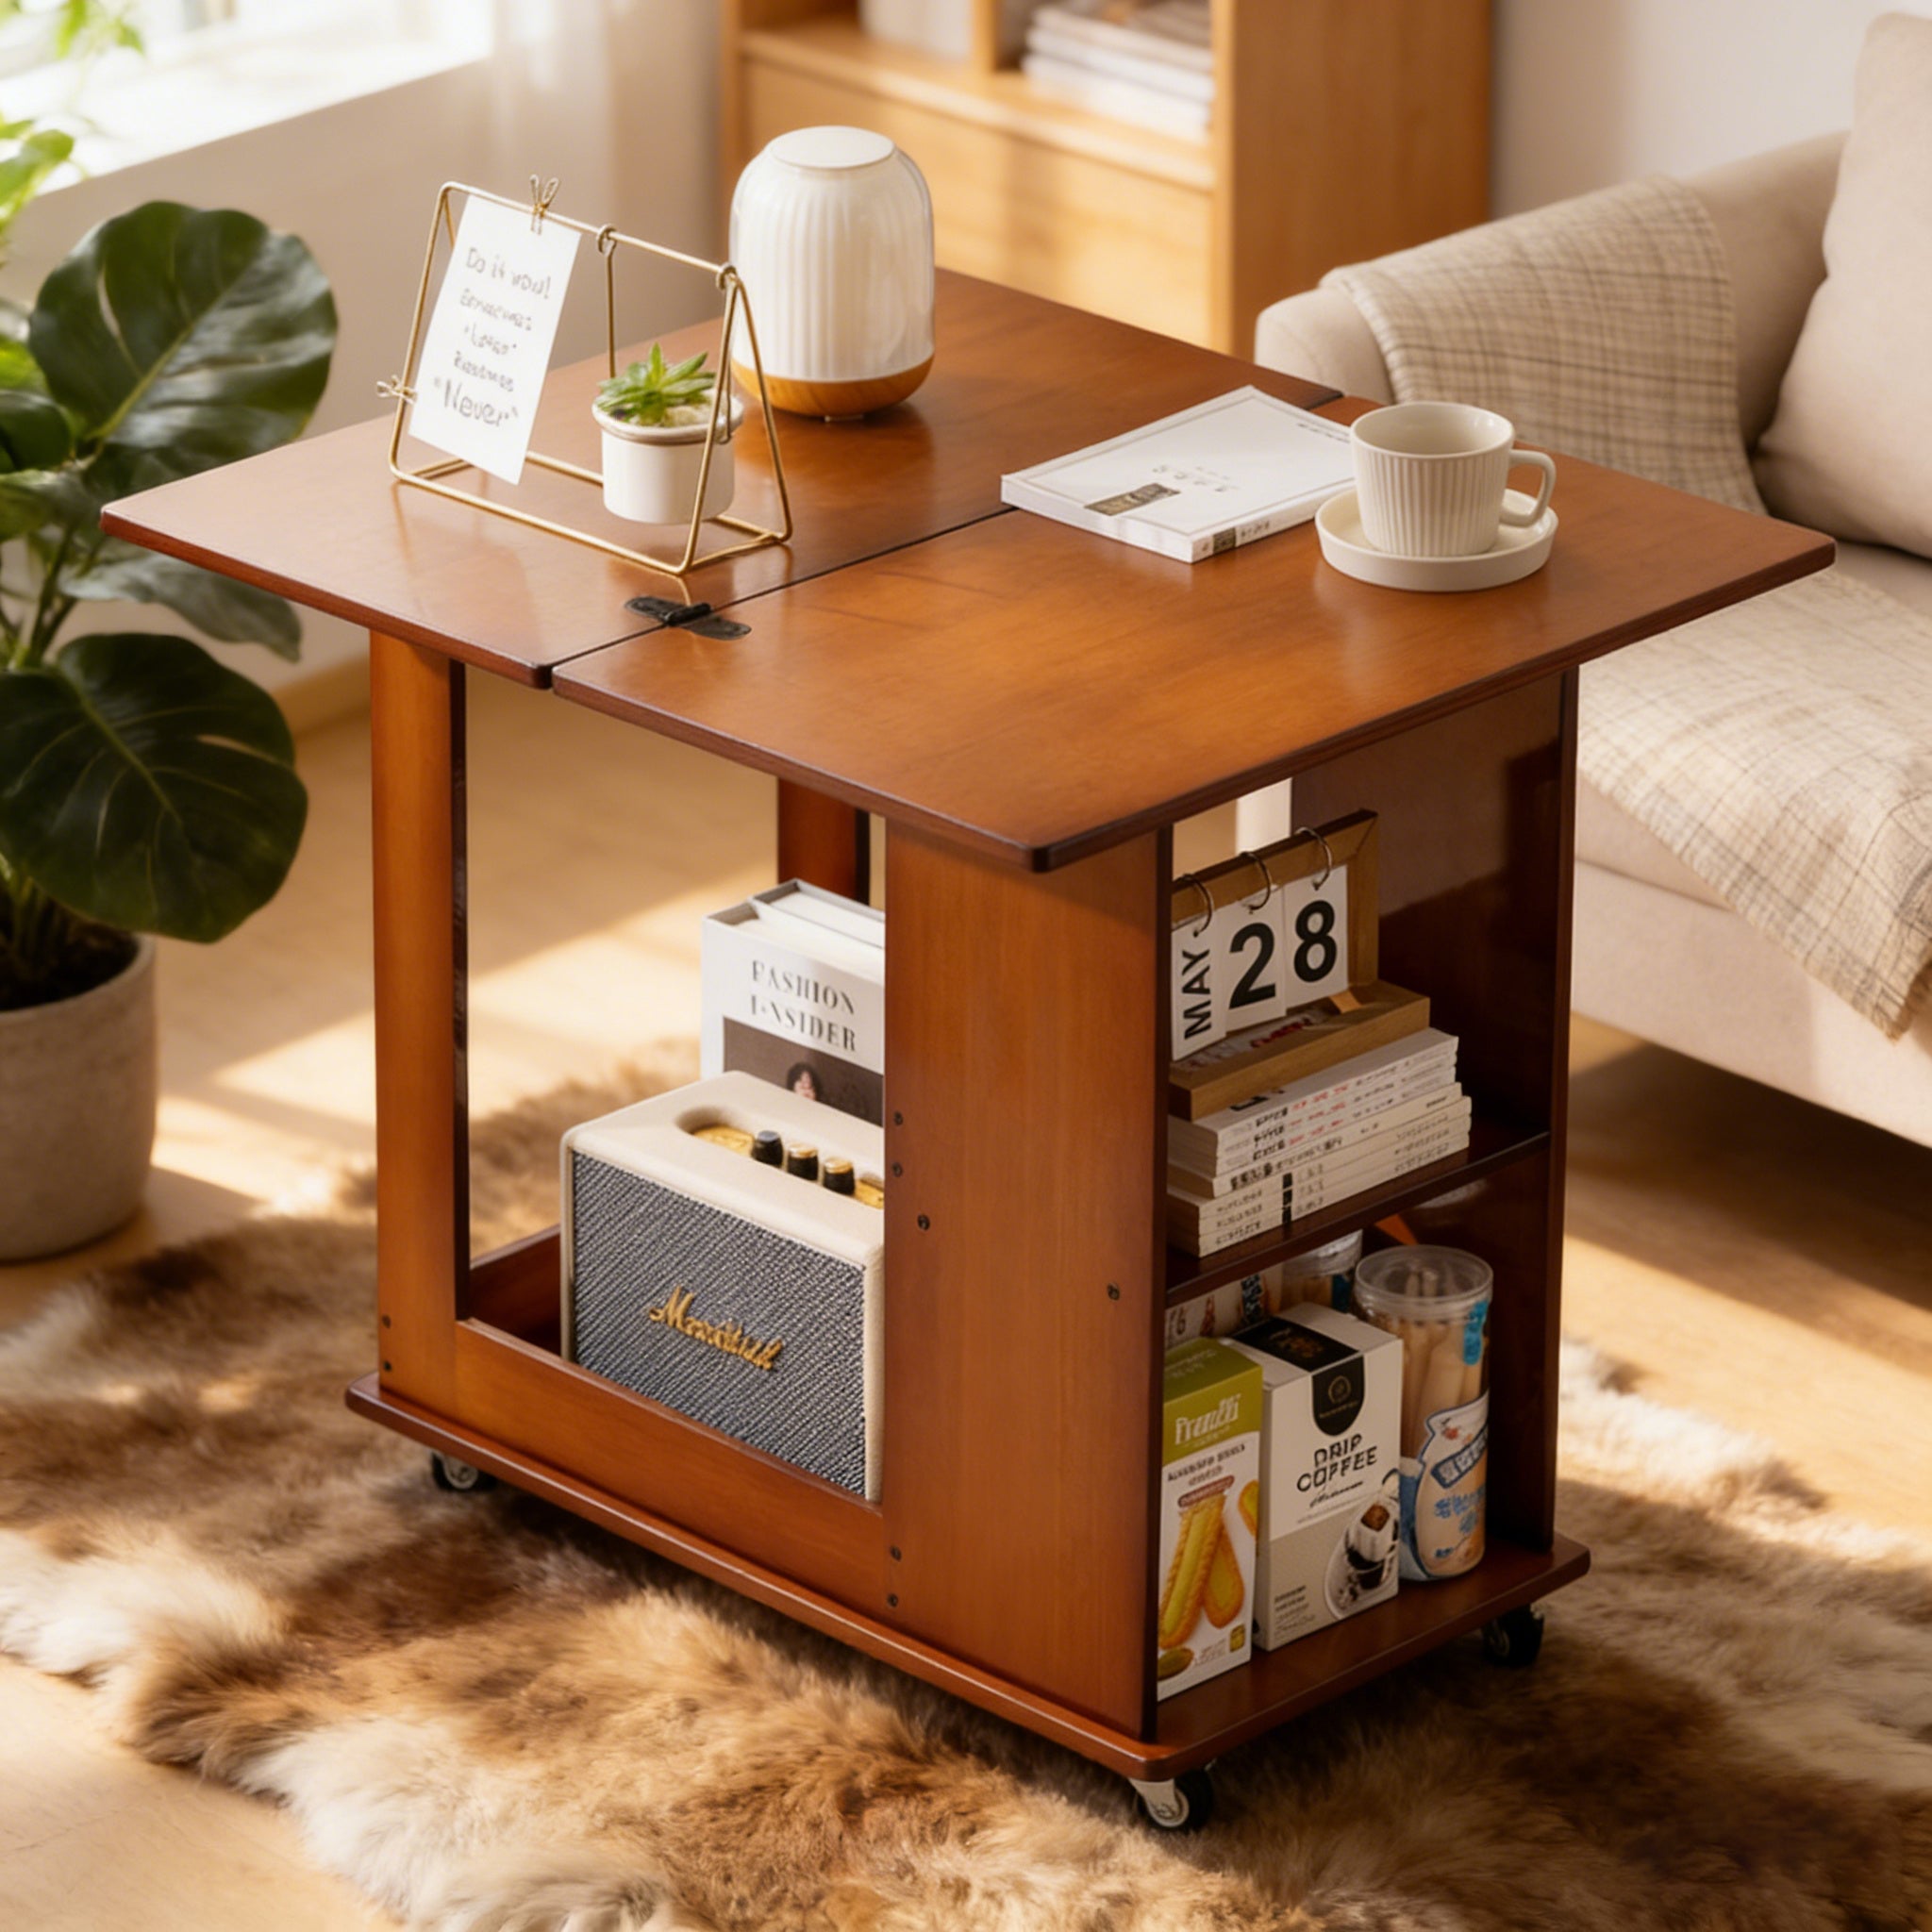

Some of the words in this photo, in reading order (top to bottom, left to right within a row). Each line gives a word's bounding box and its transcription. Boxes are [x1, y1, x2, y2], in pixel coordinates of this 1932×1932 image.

[1182, 949, 1212, 1041] MAY
[1296, 1445, 1378, 1492] COFFEE
[1314, 1433, 1363, 1469] DRIP
